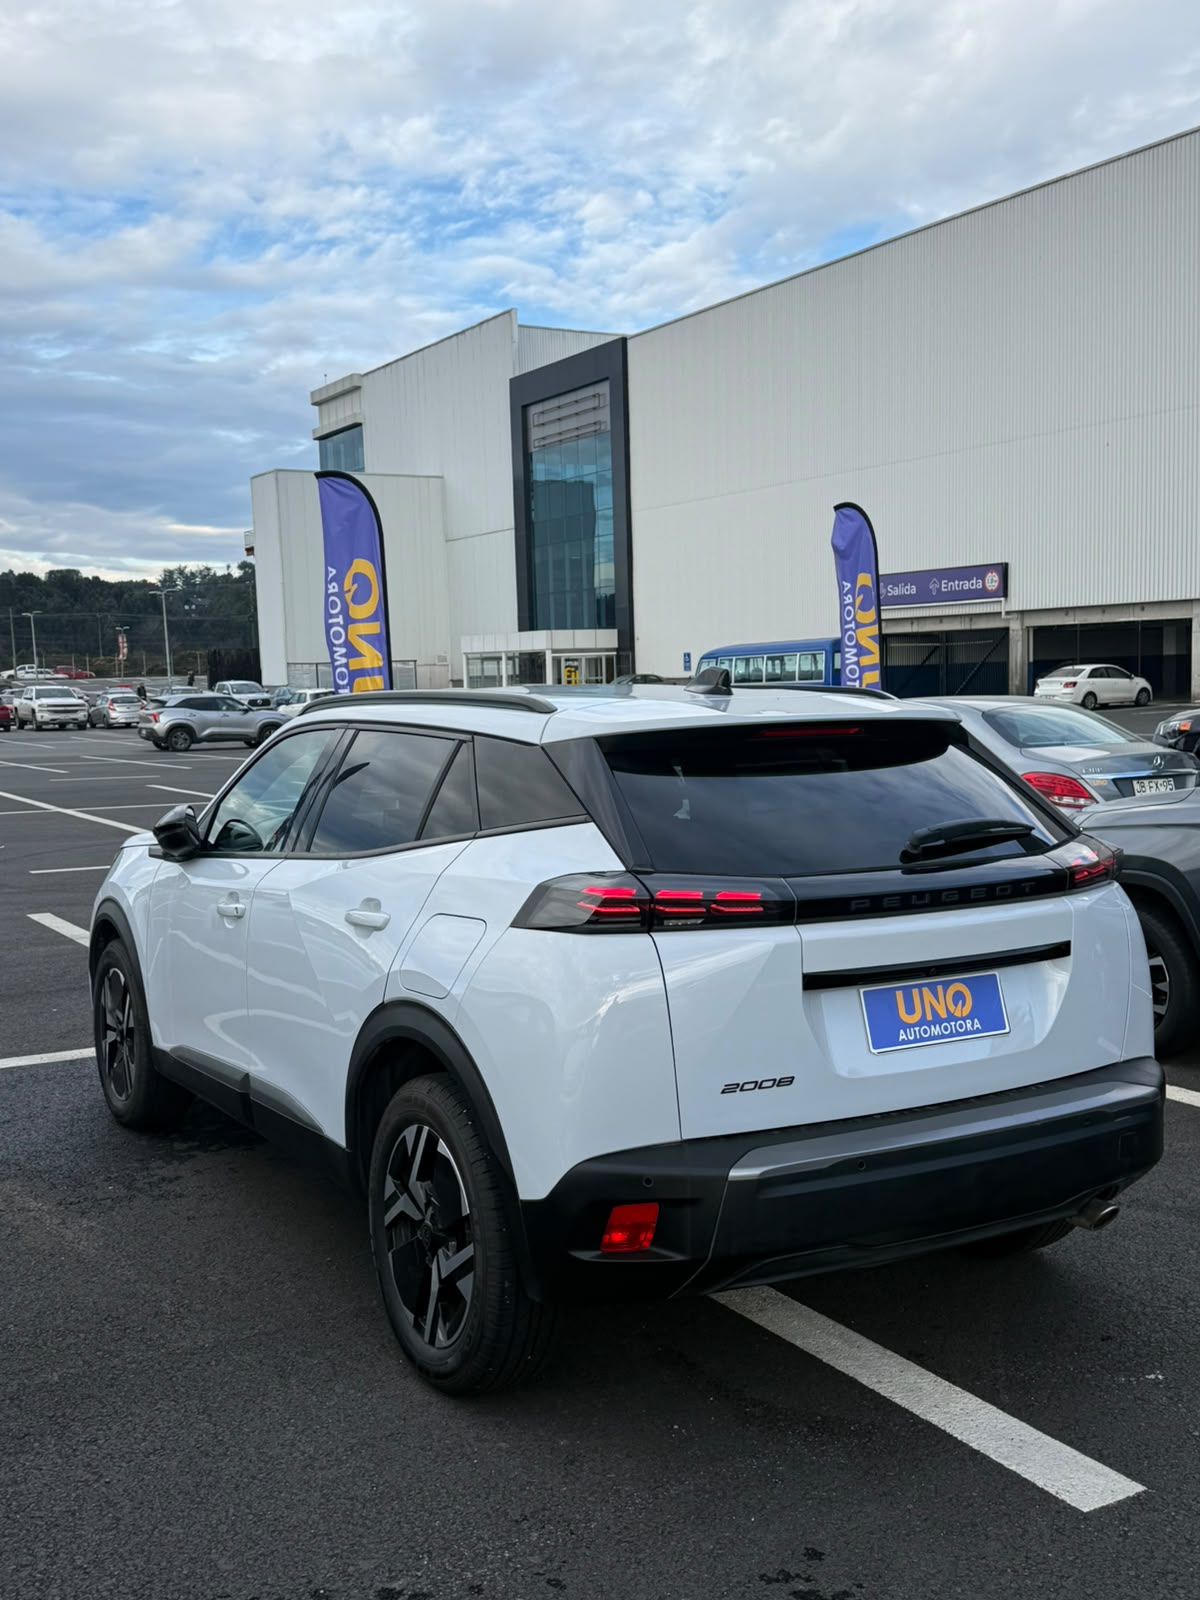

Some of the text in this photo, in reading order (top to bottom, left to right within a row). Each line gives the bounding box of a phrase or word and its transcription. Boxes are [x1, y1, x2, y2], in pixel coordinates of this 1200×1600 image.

[887, 583, 917, 596] Salida
[941, 576, 983, 592] Entrada
[851, 882, 1036, 910] PEUGEOT
[895, 982, 973, 1024] UNO
[898, 1018, 982, 1042] AUTOMOTORA
[720, 1076, 796, 1095] 2008
